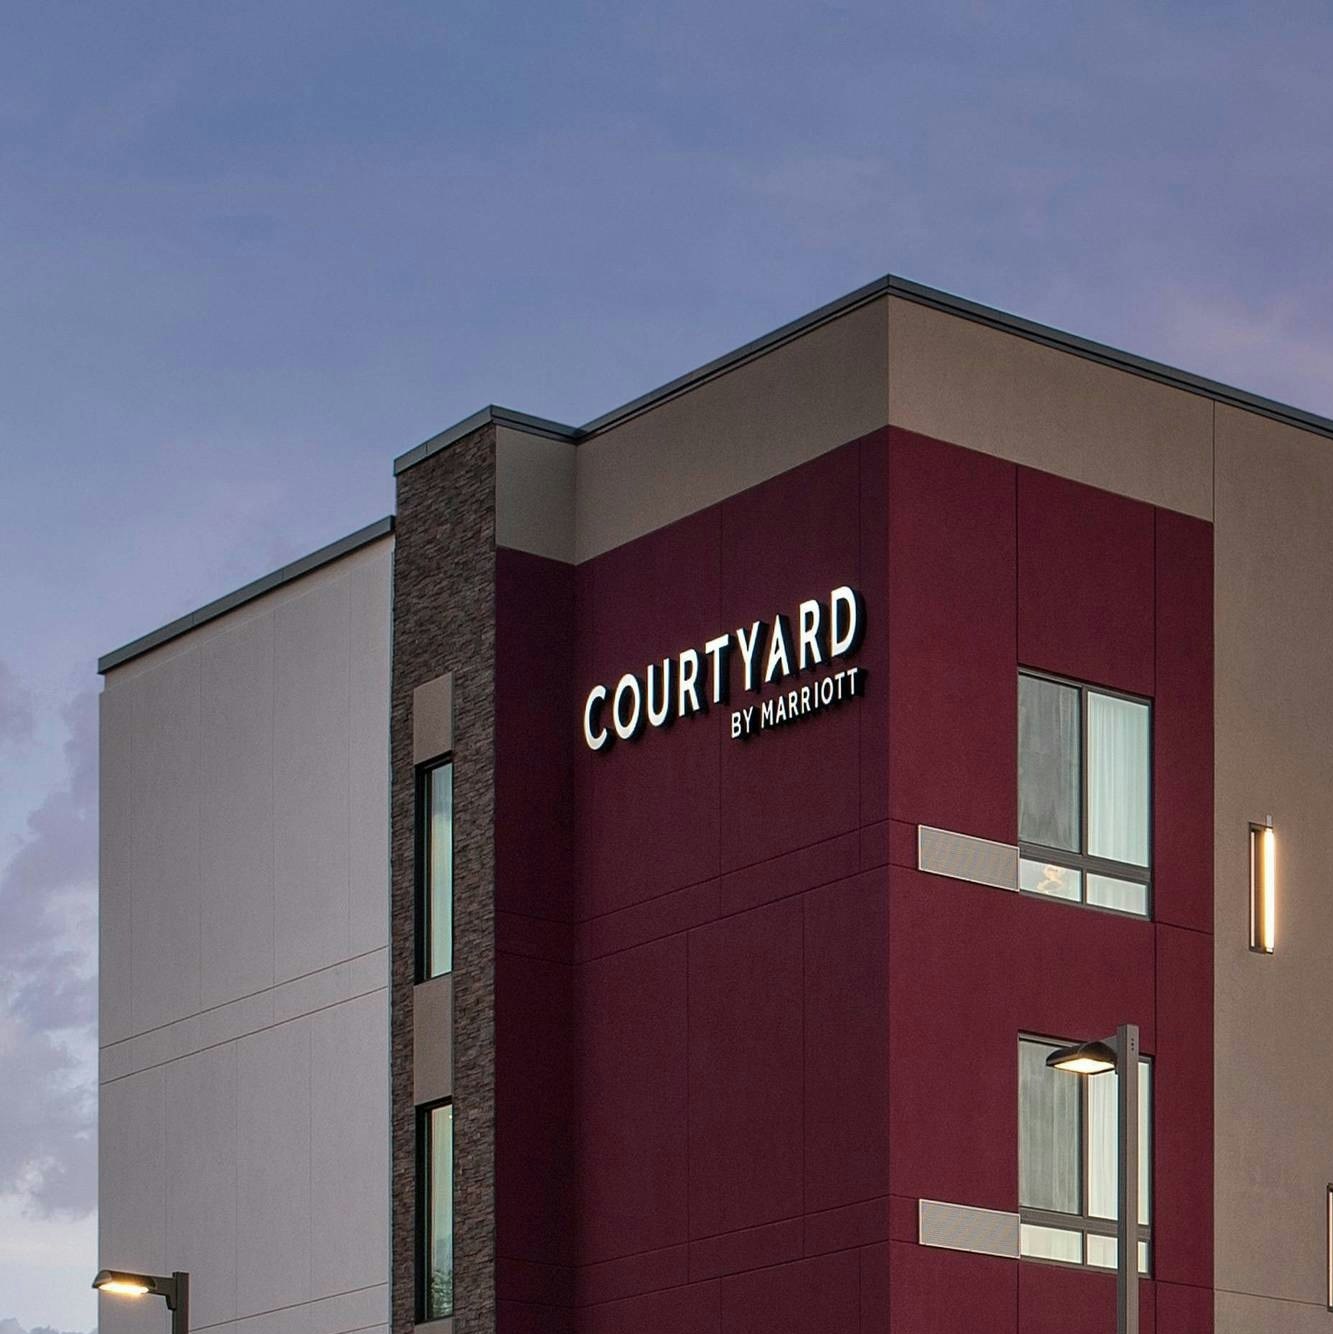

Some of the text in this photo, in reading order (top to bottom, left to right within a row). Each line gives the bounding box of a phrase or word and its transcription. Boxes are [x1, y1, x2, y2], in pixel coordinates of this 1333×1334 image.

[583, 585, 857, 750] COURTYARD
[731, 667, 859, 739] BY MARRIOTT
